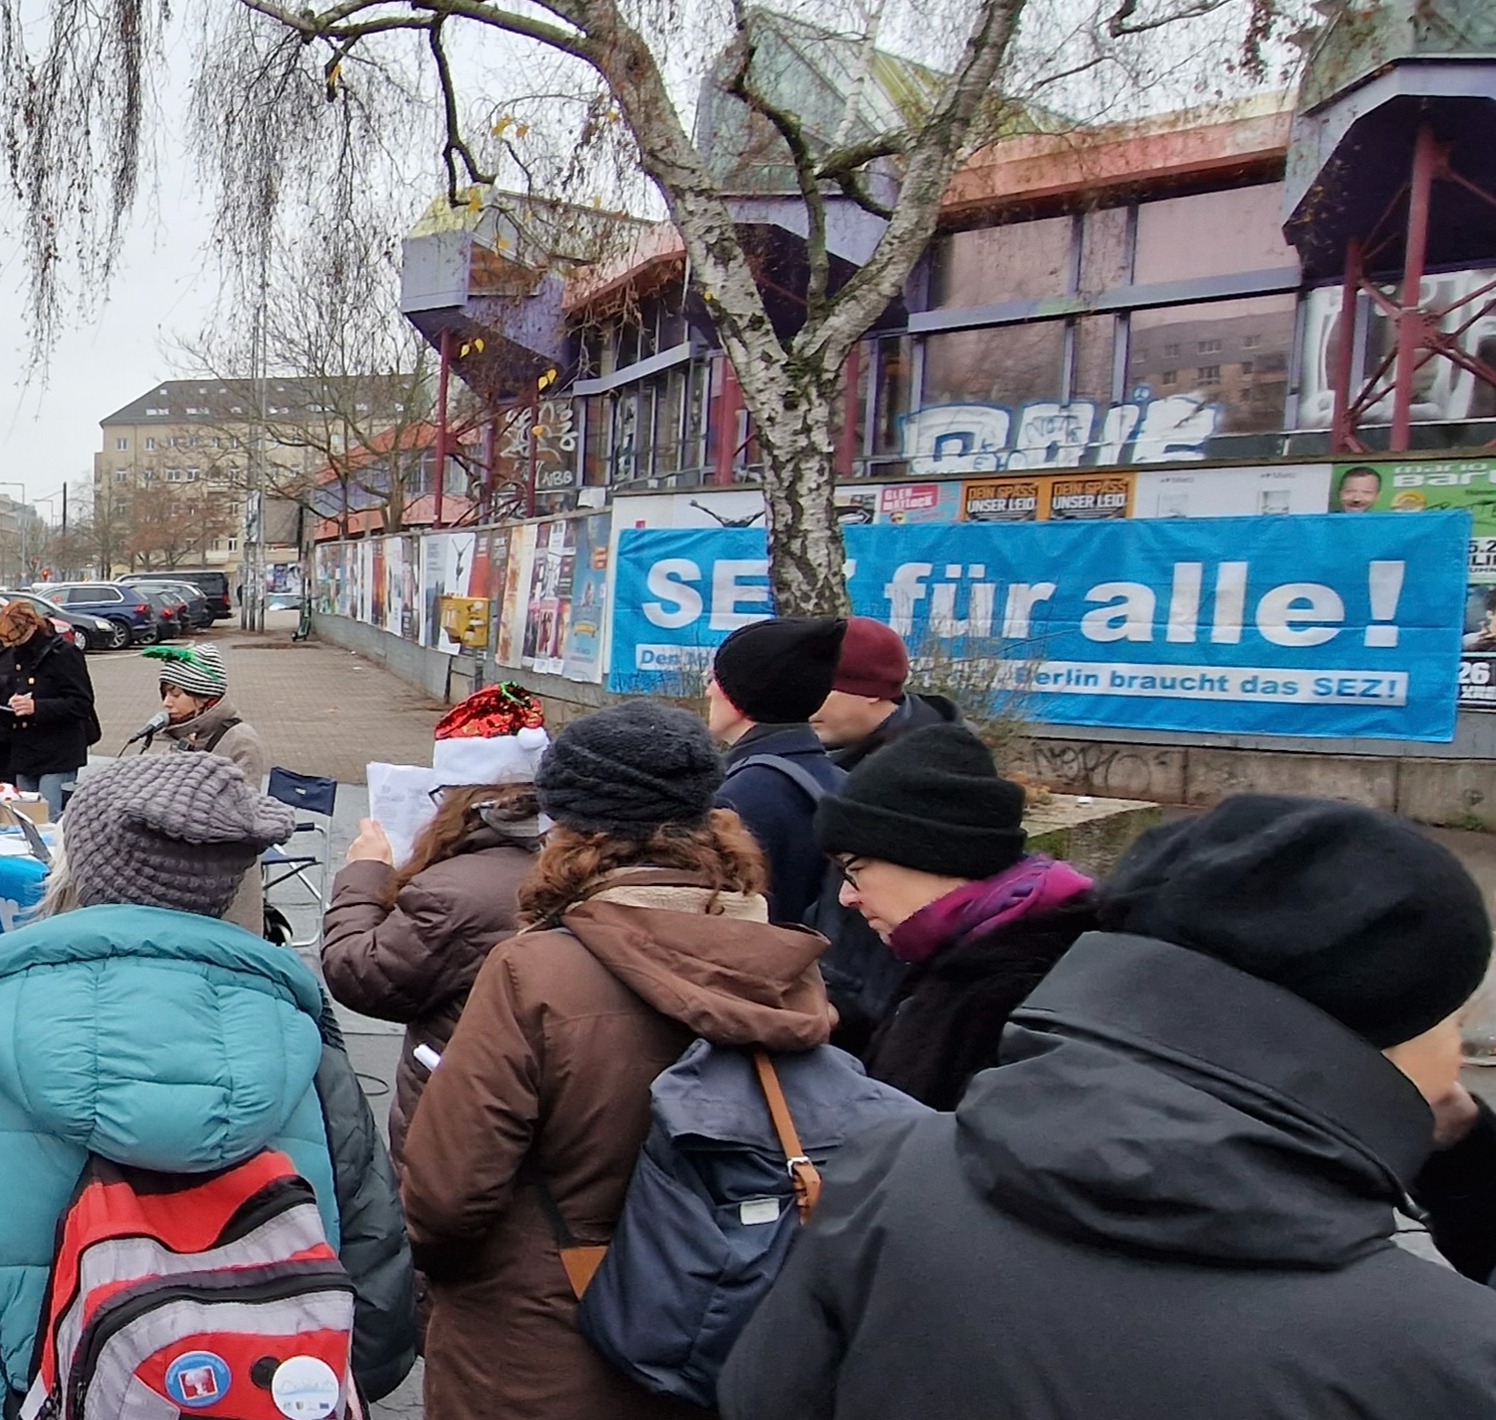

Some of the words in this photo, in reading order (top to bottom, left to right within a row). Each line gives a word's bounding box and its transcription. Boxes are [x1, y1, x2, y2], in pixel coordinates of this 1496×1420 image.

[968, 487, 995, 500] DEIN
[998, 484, 1037, 498] SPASS
[1054, 482, 1082, 496] DEIN
[1085, 479, 1129, 495] SPASS
[967, 498, 1005, 512] UNSER
[1008, 496, 1036, 510] LEID
[1053, 495, 1095, 510] UNSER
[1097, 493, 1126, 508] LEID
[641, 557, 857, 632] SE
[883, 562, 1057, 640] für
[1080, 560, 1406, 648] alle!
[641, 650, 681, 665] Den
[1109, 670, 1230, 693] braucht
[1239, 674, 1300, 696] das
[1311, 676, 1398, 699] SEZ!
